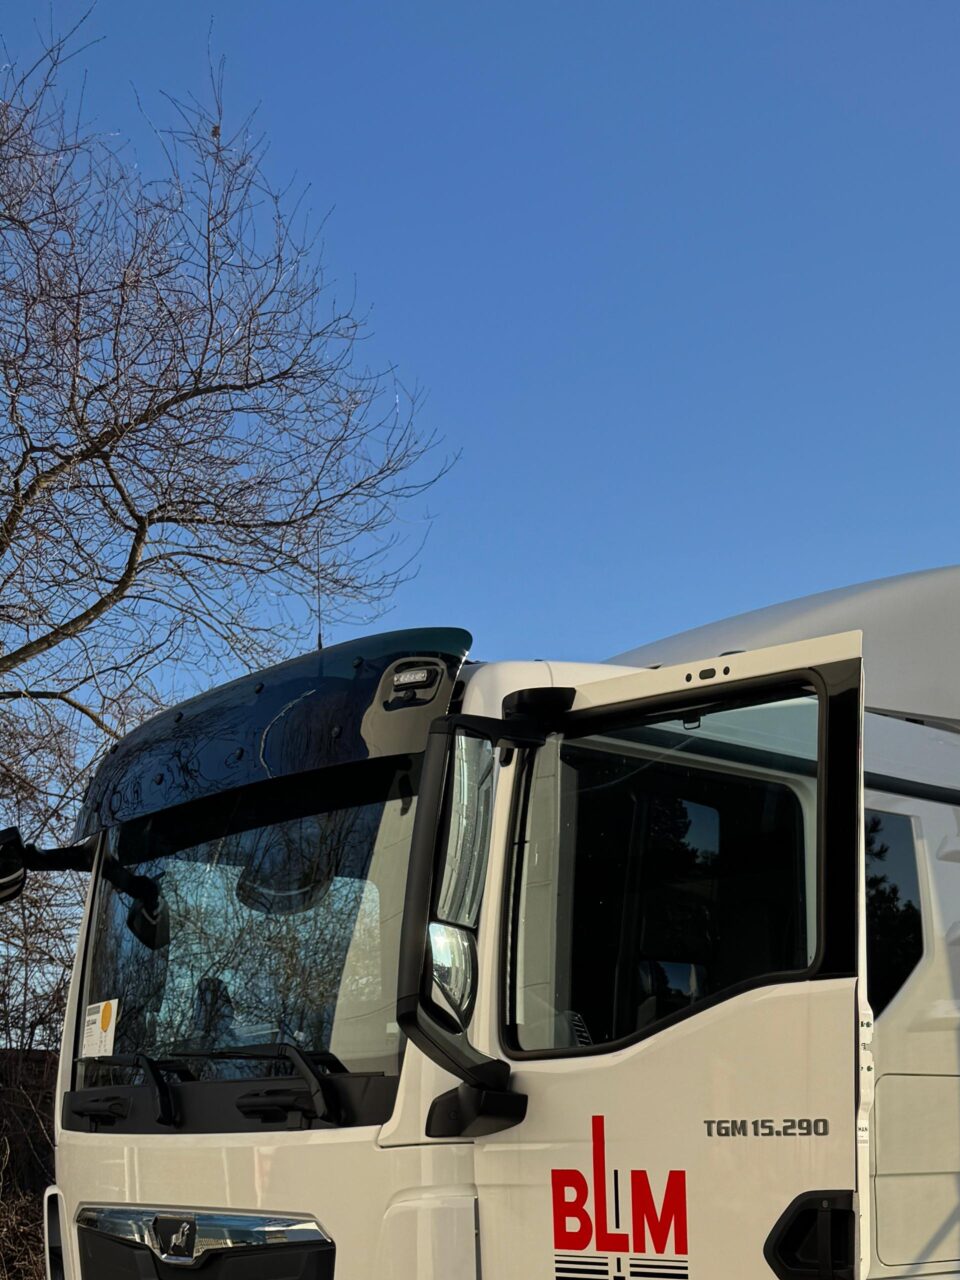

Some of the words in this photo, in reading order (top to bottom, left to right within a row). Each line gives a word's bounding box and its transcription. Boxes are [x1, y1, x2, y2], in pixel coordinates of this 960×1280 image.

[703, 1119, 748, 1137] TGM
[751, 1118, 829, 1137] 15.290
[551, 1115, 688, 1255] BLM
